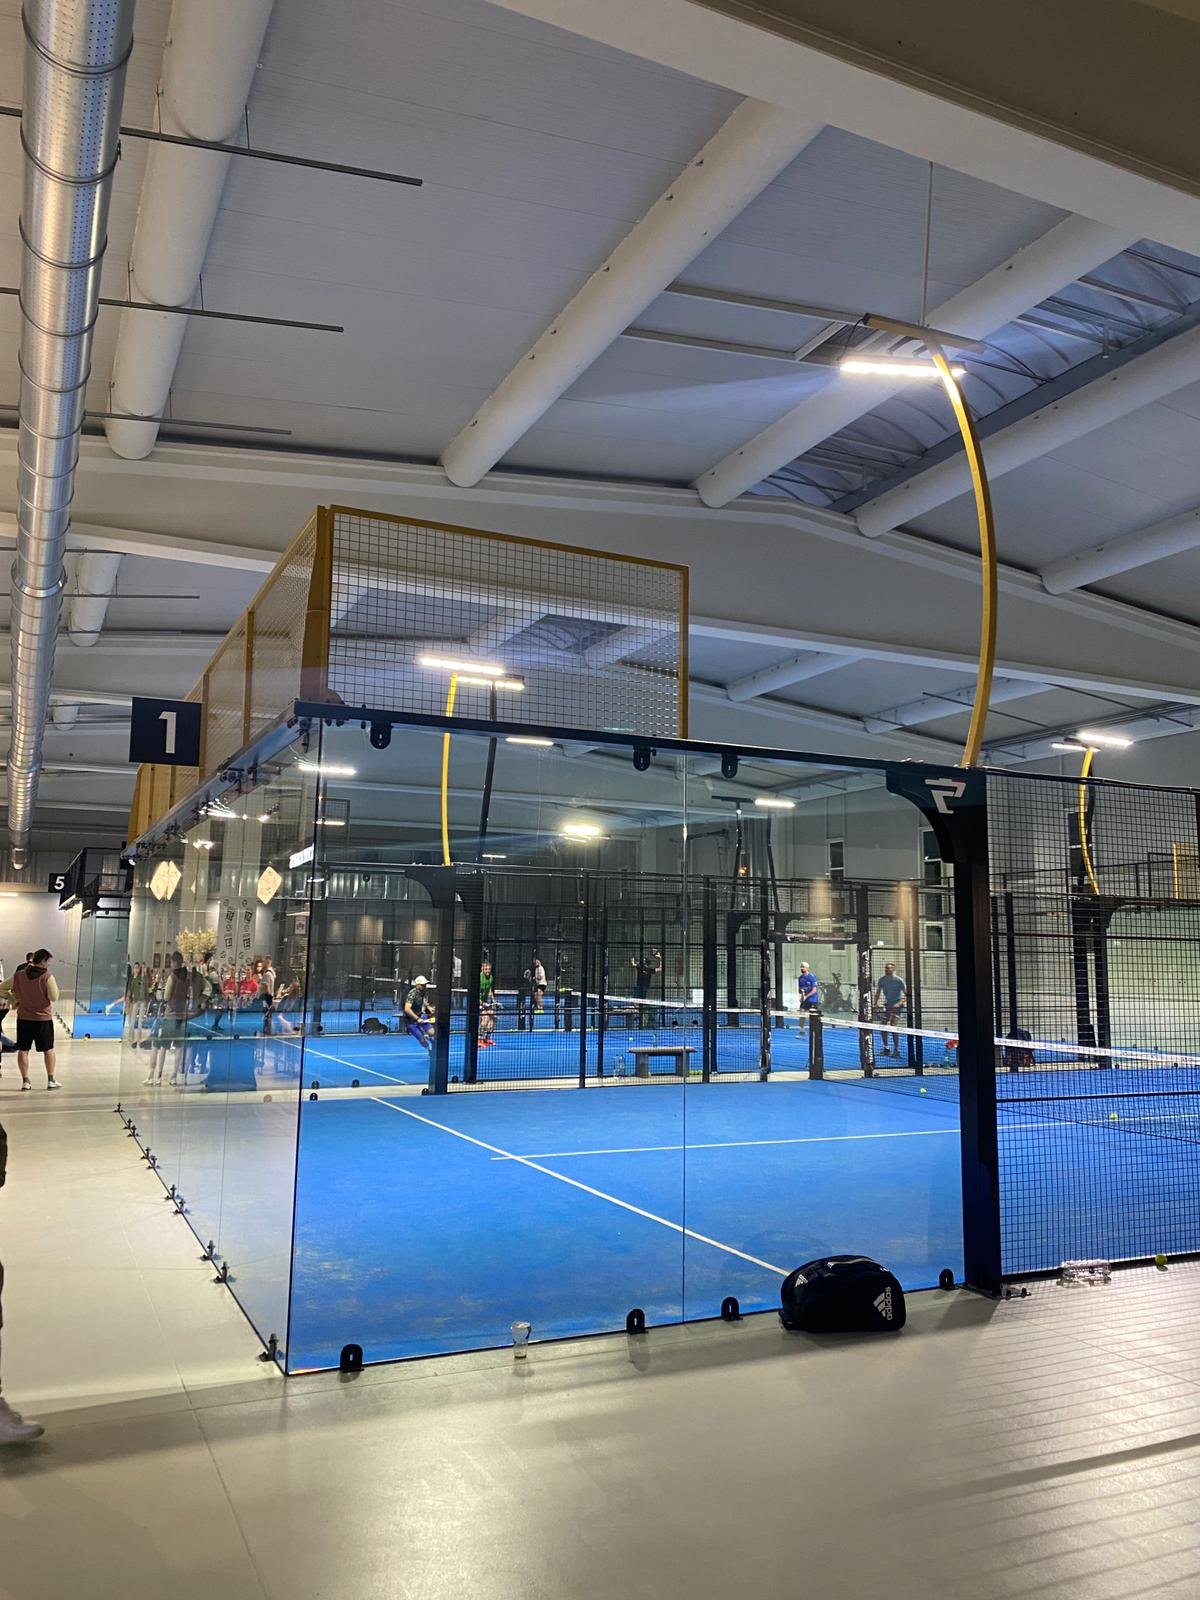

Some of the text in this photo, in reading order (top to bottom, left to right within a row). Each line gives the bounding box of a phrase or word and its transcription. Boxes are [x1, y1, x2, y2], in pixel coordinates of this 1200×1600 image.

[158, 711, 177, 754] 1
[54, 876, 65, 890] 5
[885, 1286, 893, 1321] adidas
